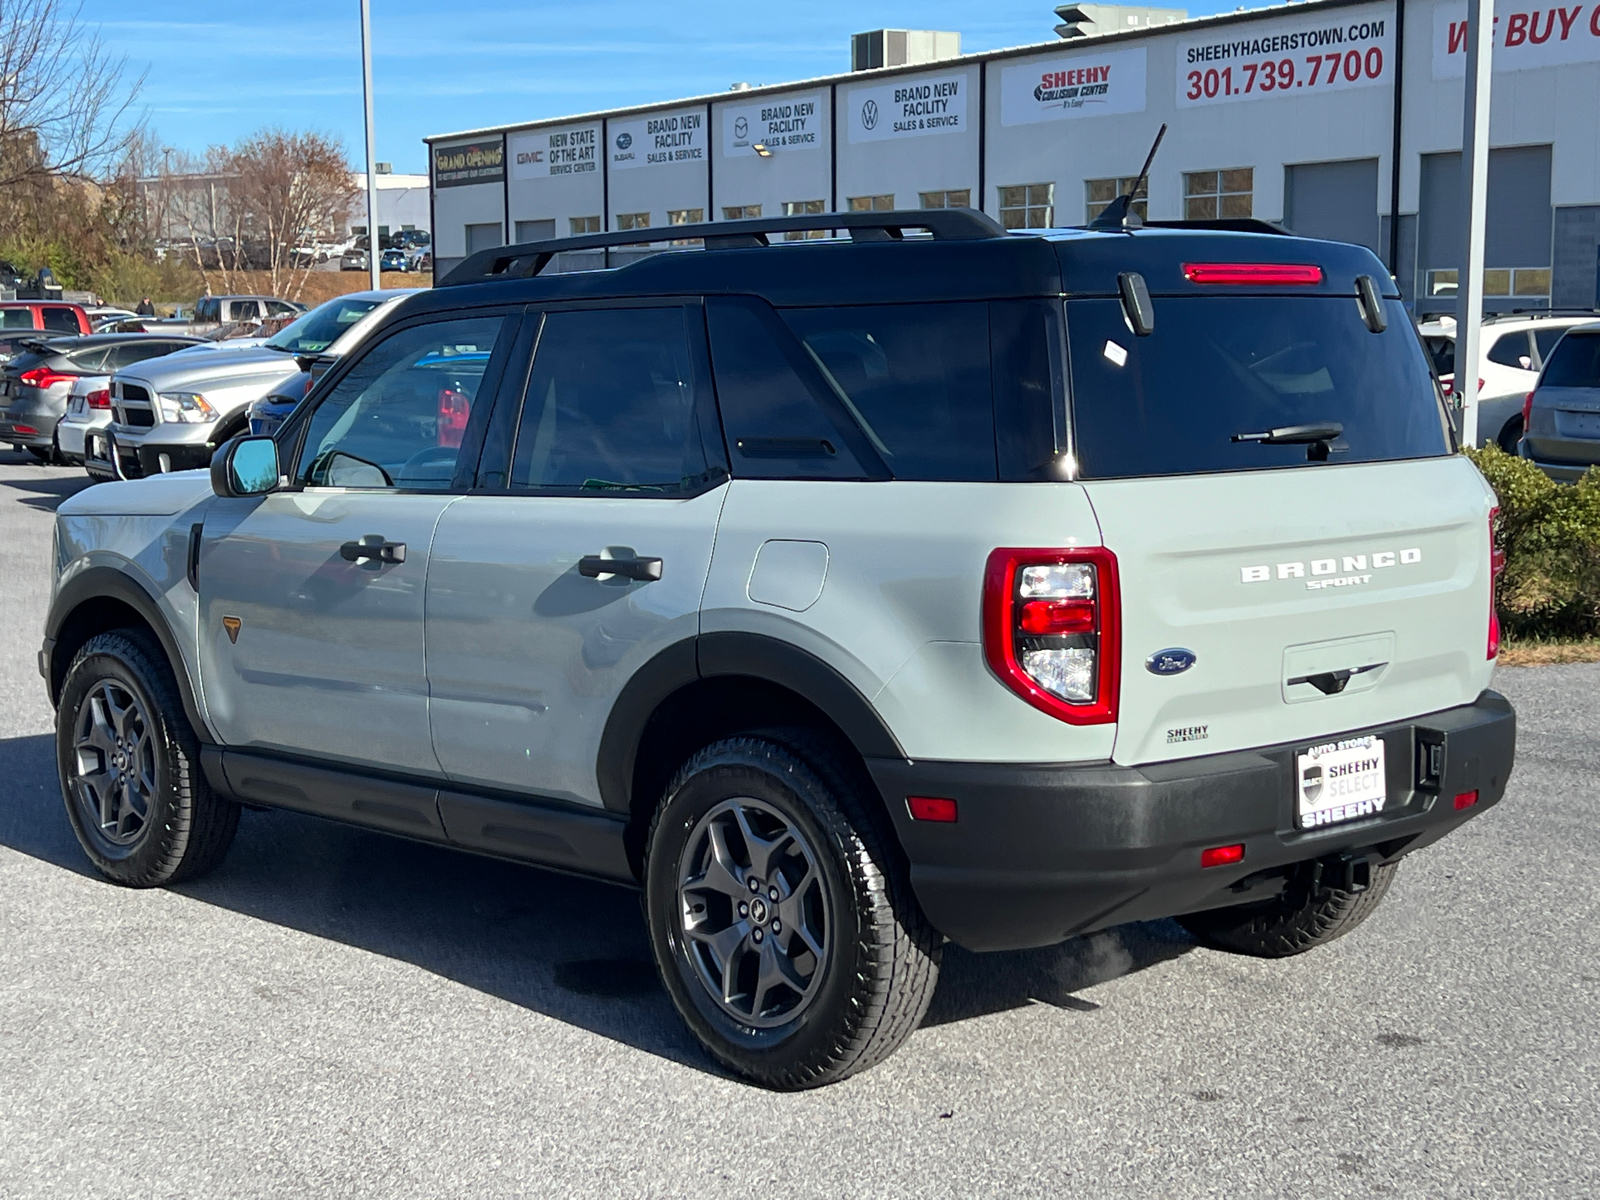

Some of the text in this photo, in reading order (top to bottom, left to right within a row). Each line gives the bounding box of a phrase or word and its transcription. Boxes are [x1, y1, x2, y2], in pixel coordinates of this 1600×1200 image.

[1504, 5, 1583, 47] BUY
[1187, 21, 1385, 64] SHEEHYHAGERSTOWN.COM
[1042, 65, 1111, 89] SHEEHY
[1187, 46, 1383, 101] 301.739.7700
[895, 82, 958, 103] BRAND NEW
[1042, 83, 1109, 101] COLLISION CENTER
[761, 102, 814, 121] BRAND NEW
[903, 98, 948, 117] FACILITY
[647, 114, 701, 134] BRAND NEW
[768, 118, 806, 134] FACILITY
[893, 115, 958, 132] SALES & SERVICE
[550, 130, 595, 148] NEW STATE
[655, 131, 693, 149] FACILITY
[782, 136, 787, 146] &
[788, 133, 815, 145] SERVICE
[437, 148, 502, 170] GRAND OPENING
[517, 151, 544, 165] GMC
[549, 146, 595, 163] OF THE ART
[647, 151, 667, 163] SALES
[675, 148, 702, 161] SERVICE
[550, 162, 596, 175] SERVICE CENTER
[1240, 548, 1421, 583] BRONCO
[1306, 574, 1373, 590] SPORT
[1159, 656, 1187, 670] Ford
[1167, 725, 1208, 738] SHEEHY
[1307, 735, 1376, 759] AUTO STORES
[1329, 757, 1380, 778] SHEEHY
[1329, 772, 1380, 798] SELECT
[1301, 798, 1387, 828] SHEEHY
